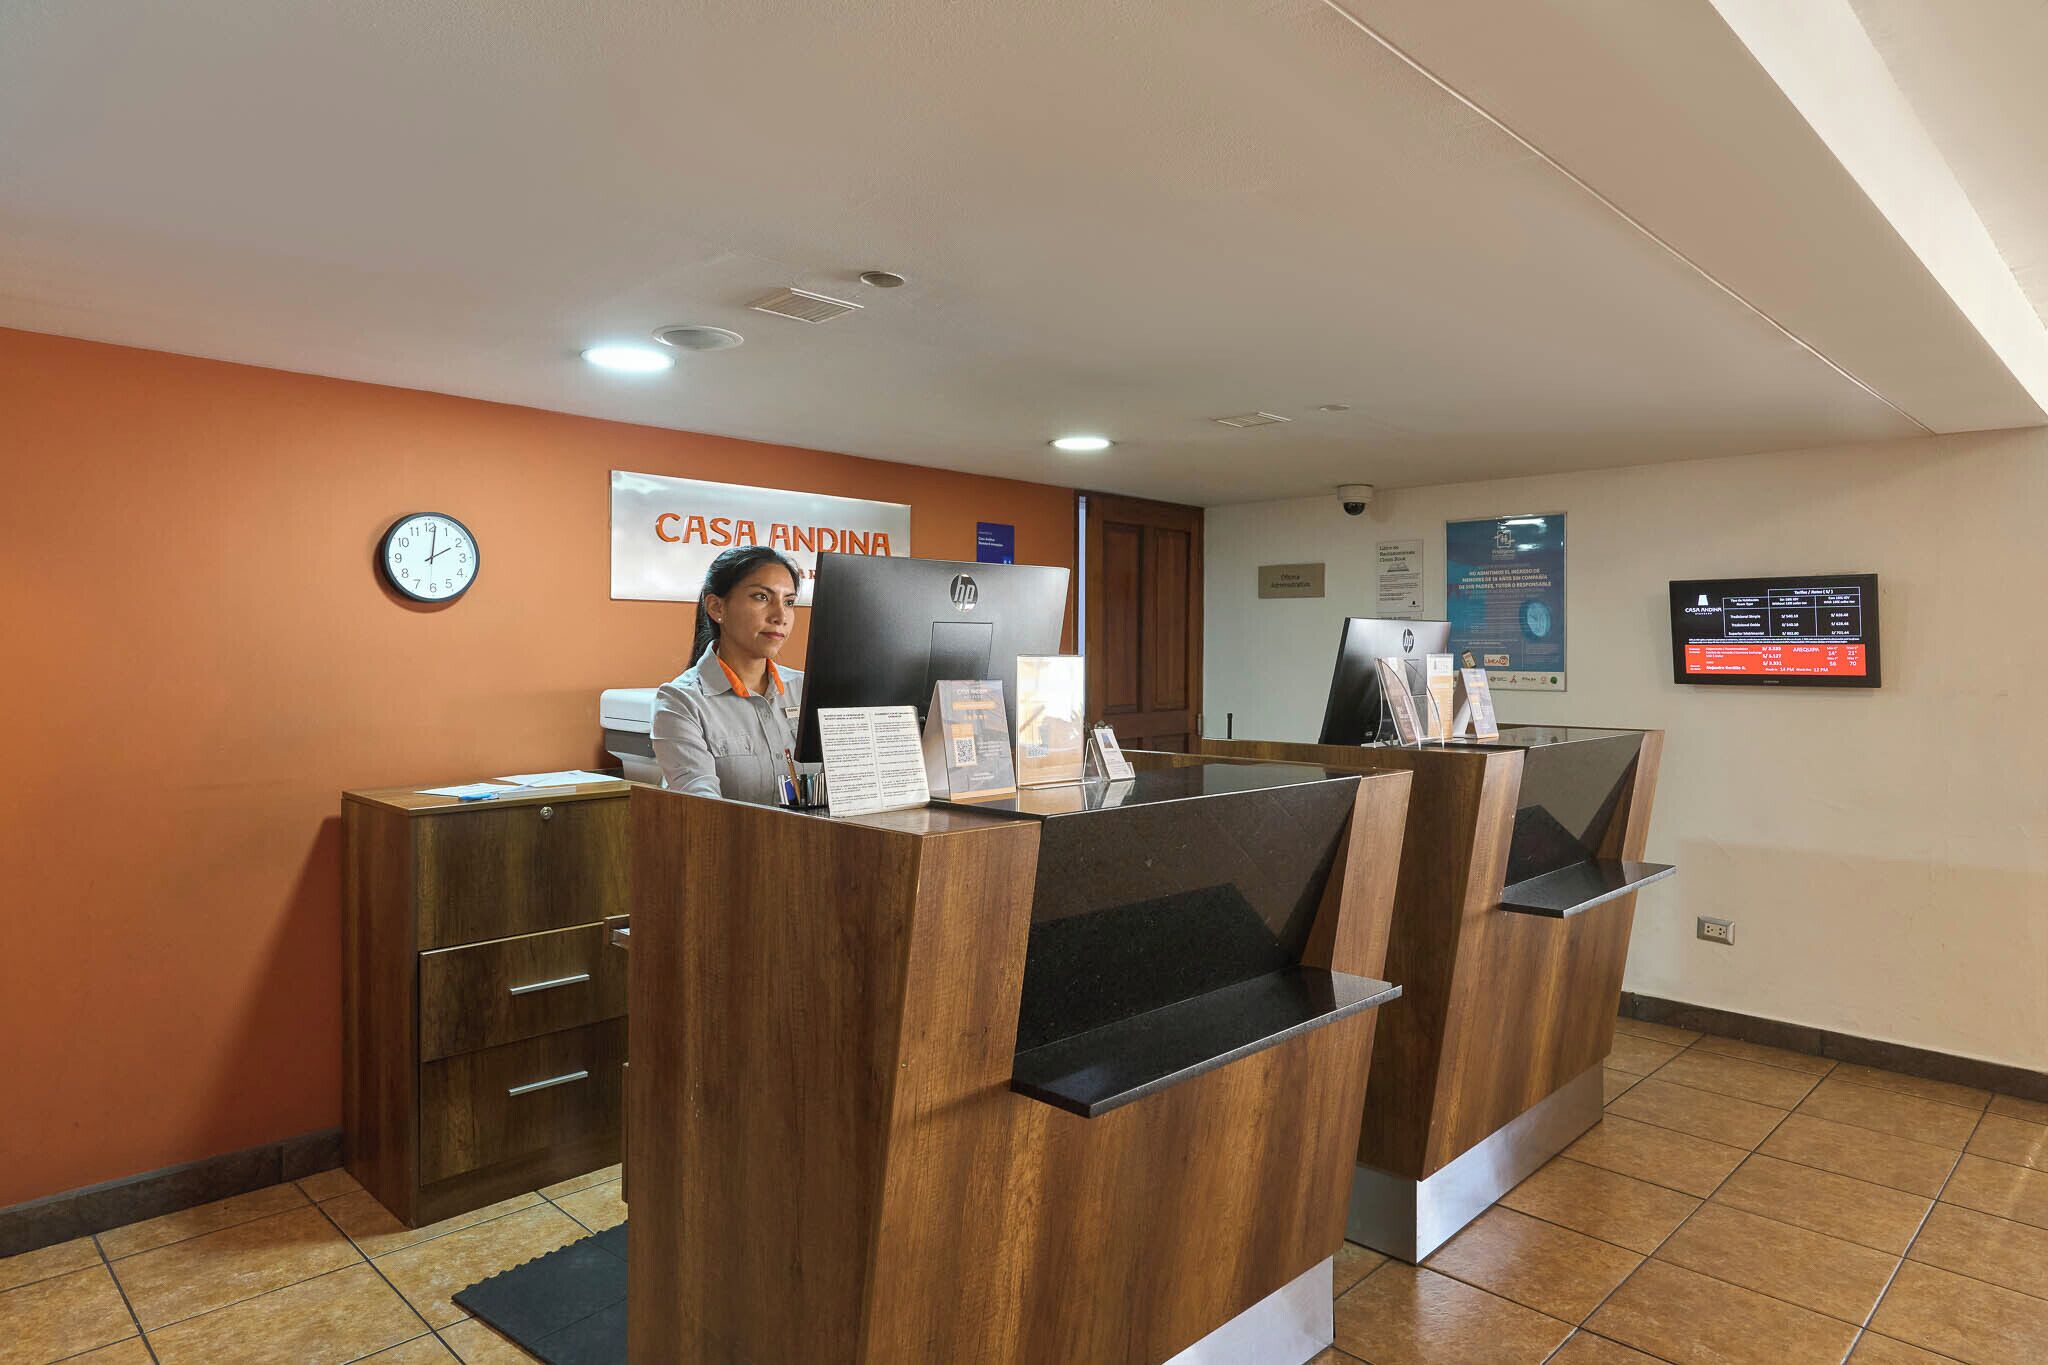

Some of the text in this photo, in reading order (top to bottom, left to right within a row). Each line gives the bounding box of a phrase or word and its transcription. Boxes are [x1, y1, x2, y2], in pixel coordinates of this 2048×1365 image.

[410, 526, 419, 536] 11
[424, 522, 436, 532] 12
[444, 528, 448, 536] 1
[655, 512, 891, 556] CASA ANDINA
[398, 538, 409, 548] 10
[455, 538, 462, 548] 2
[394, 553, 402, 563] 9
[459, 553, 466, 563] 3
[402, 568, 409, 578] 8
[457, 568, 463, 578] 4
[414, 579, 421, 589] 7
[430, 583, 437, 593] 6
[445, 579, 452, 588] 5
[951, 574, 978, 610] hp
[1403, 628, 1414, 653] hp
